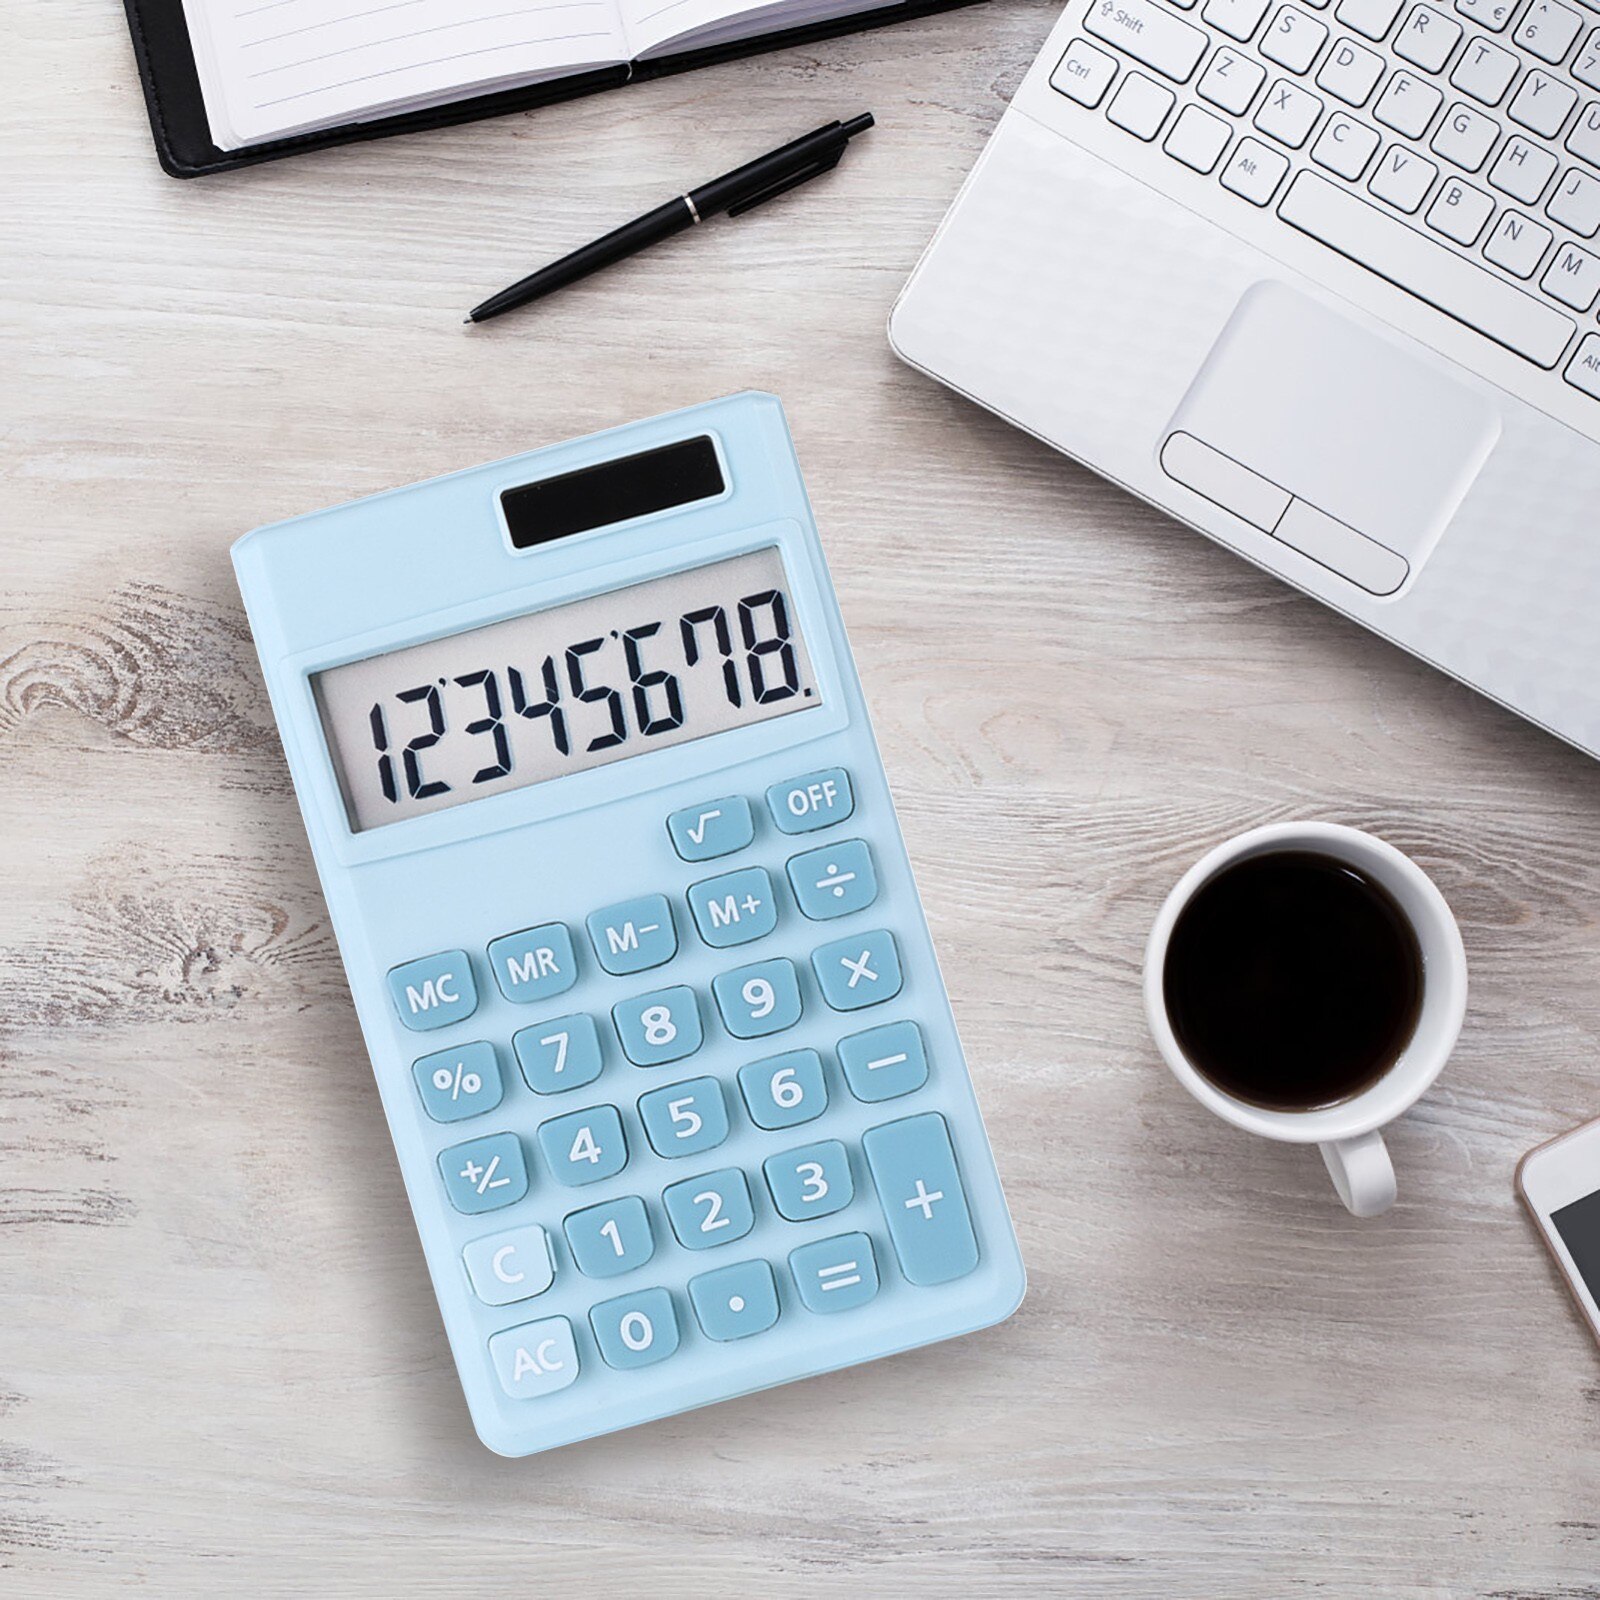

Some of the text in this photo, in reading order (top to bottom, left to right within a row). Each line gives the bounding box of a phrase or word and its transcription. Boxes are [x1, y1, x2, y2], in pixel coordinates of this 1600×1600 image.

[1113, 9, 1144, 34] Shift
[1280, 16, 1295, 33] S
[1413, 13, 1429, 33] R
[1526, 25, 1537, 38] 6
[1337, 48, 1354, 66] D
[1475, 46, 1490, 64] T
[1584, 56, 1596, 69] 7
[1066, 59, 1091, 79] Ctrl
[1217, 57, 1233, 76] Z
[1394, 80, 1410, 94] F
[1533, 78, 1547, 96] Y
[1274, 90, 1291, 109] X
[1333, 124, 1350, 142] C
[1454, 114, 1470, 133] G
[1393, 155, 1407, 173] V
[1509, 145, 1528, 166] H
[1238, 158, 1257, 176] Alt
[1446, 187, 1462, 206] B
[1567, 180, 1581, 195] J
[1504, 220, 1523, 240] N
[1562, 253, 1583, 275] M
[1582, 354, 1600, 372] Alt
[787, 779, 837, 815] OFF
[709, 895, 760, 927] M+
[507, 948, 559, 984] MR
[407, 974, 458, 1013] MC
[743, 979, 774, 1017] 9
[641, 1006, 676, 1044] 8
[541, 1032, 568, 1072] 7
[433, 1063, 481, 1100] %
[771, 1069, 802, 1107] 6
[669, 1097, 701, 1137] 5
[570, 1127, 601, 1163] 4
[797, 1163, 827, 1201] 3
[694, 1192, 729, 1231] 2
[601, 1221, 624, 1255] 1
[493, 1246, 524, 1283] C
[621, 1312, 652, 1350] 0
[514, 1340, 563, 1380] AC
